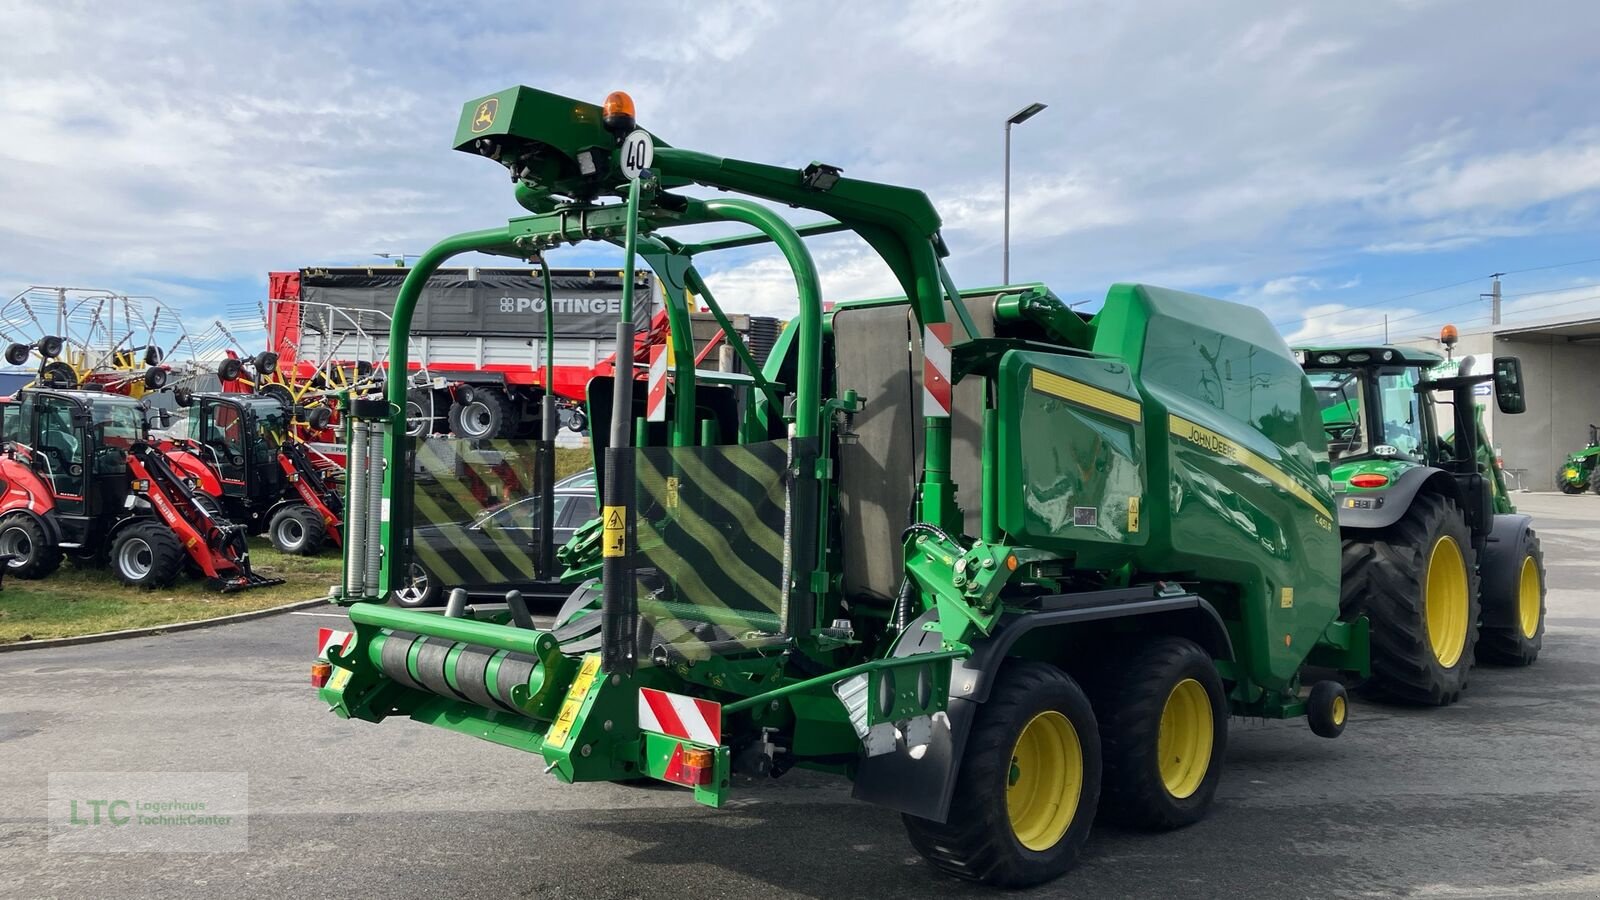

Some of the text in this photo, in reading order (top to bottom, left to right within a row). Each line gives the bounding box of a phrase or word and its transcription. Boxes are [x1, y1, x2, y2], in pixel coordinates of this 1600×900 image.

[626, 139, 646, 171] 40
[516, 297, 634, 314] PÖTTINGE
[1188, 426, 1237, 460] JOHN DEERE
[153, 493, 177, 523] MANITOU
